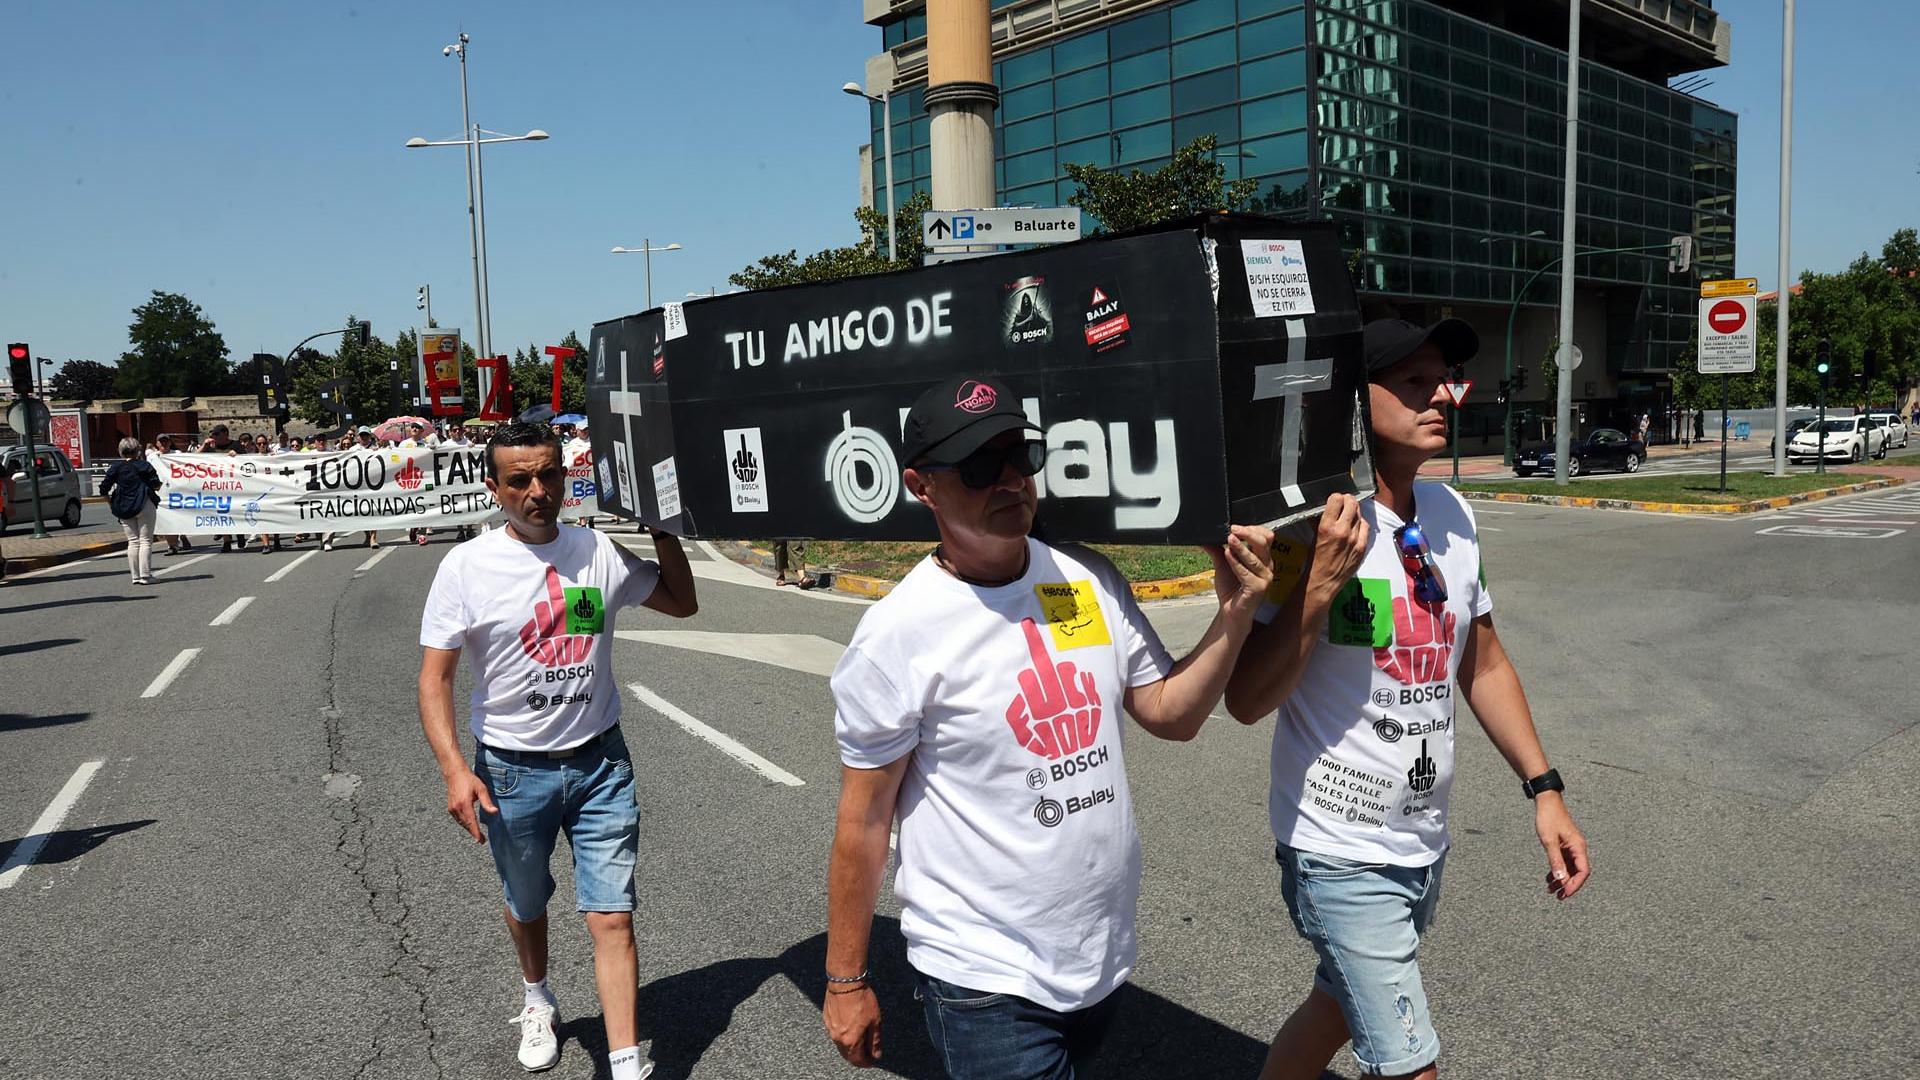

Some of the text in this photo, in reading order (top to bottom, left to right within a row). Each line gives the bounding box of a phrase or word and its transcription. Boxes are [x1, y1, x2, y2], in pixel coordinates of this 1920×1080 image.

[1014, 219, 1076, 232] Baluarte
[1268, 244, 1286, 252] BOSCH
[1246, 256, 1273, 265] SIEMENS
[1248, 272, 1308, 286] B/S/H ESQUIROZ
[1256, 286, 1307, 299] NO SE CIERRA
[1086, 300, 1119, 322] BALAY
[1272, 301, 1281, 312] EZ
[724, 330, 766, 370] TU
[783, 306, 895, 364] AMIGO
[906, 291, 953, 345] DE
[1022, 326, 1048, 340] BOSCH
[170, 463, 235, 479] BOSCH
[303, 455, 386, 491] 1000
[433, 450, 486, 486] FAM
[202, 481, 243, 491] APUNTA
[572, 480, 596, 497] Ba
[741, 483, 760, 491] BOSCH
[168, 491, 232, 514] Balay
[440, 492, 500, 515] BETRA
[195, 515, 236, 527] DISPARA
[1049, 587, 1080, 597] BOSCH
[545, 664, 595, 683] BOSCH
[1005, 617, 1102, 748] FUCK
[551, 691, 593, 707] Balay
[1027, 708, 1102, 760] YOU
[1049, 745, 1109, 783] BOSCH
[1317, 756, 1393, 789] 1000 FAMILIAS
[1407, 738, 1437, 790] FUCK
[1322, 772, 1382, 799] A LA CALLE
[1066, 784, 1115, 816] Balay
[1329, 788, 1344, 801] ES
[1345, 793, 1359, 805] LA
[1413, 789, 1434, 801] BOSCH
[1313, 796, 1385, 829] BOSCH Balay
